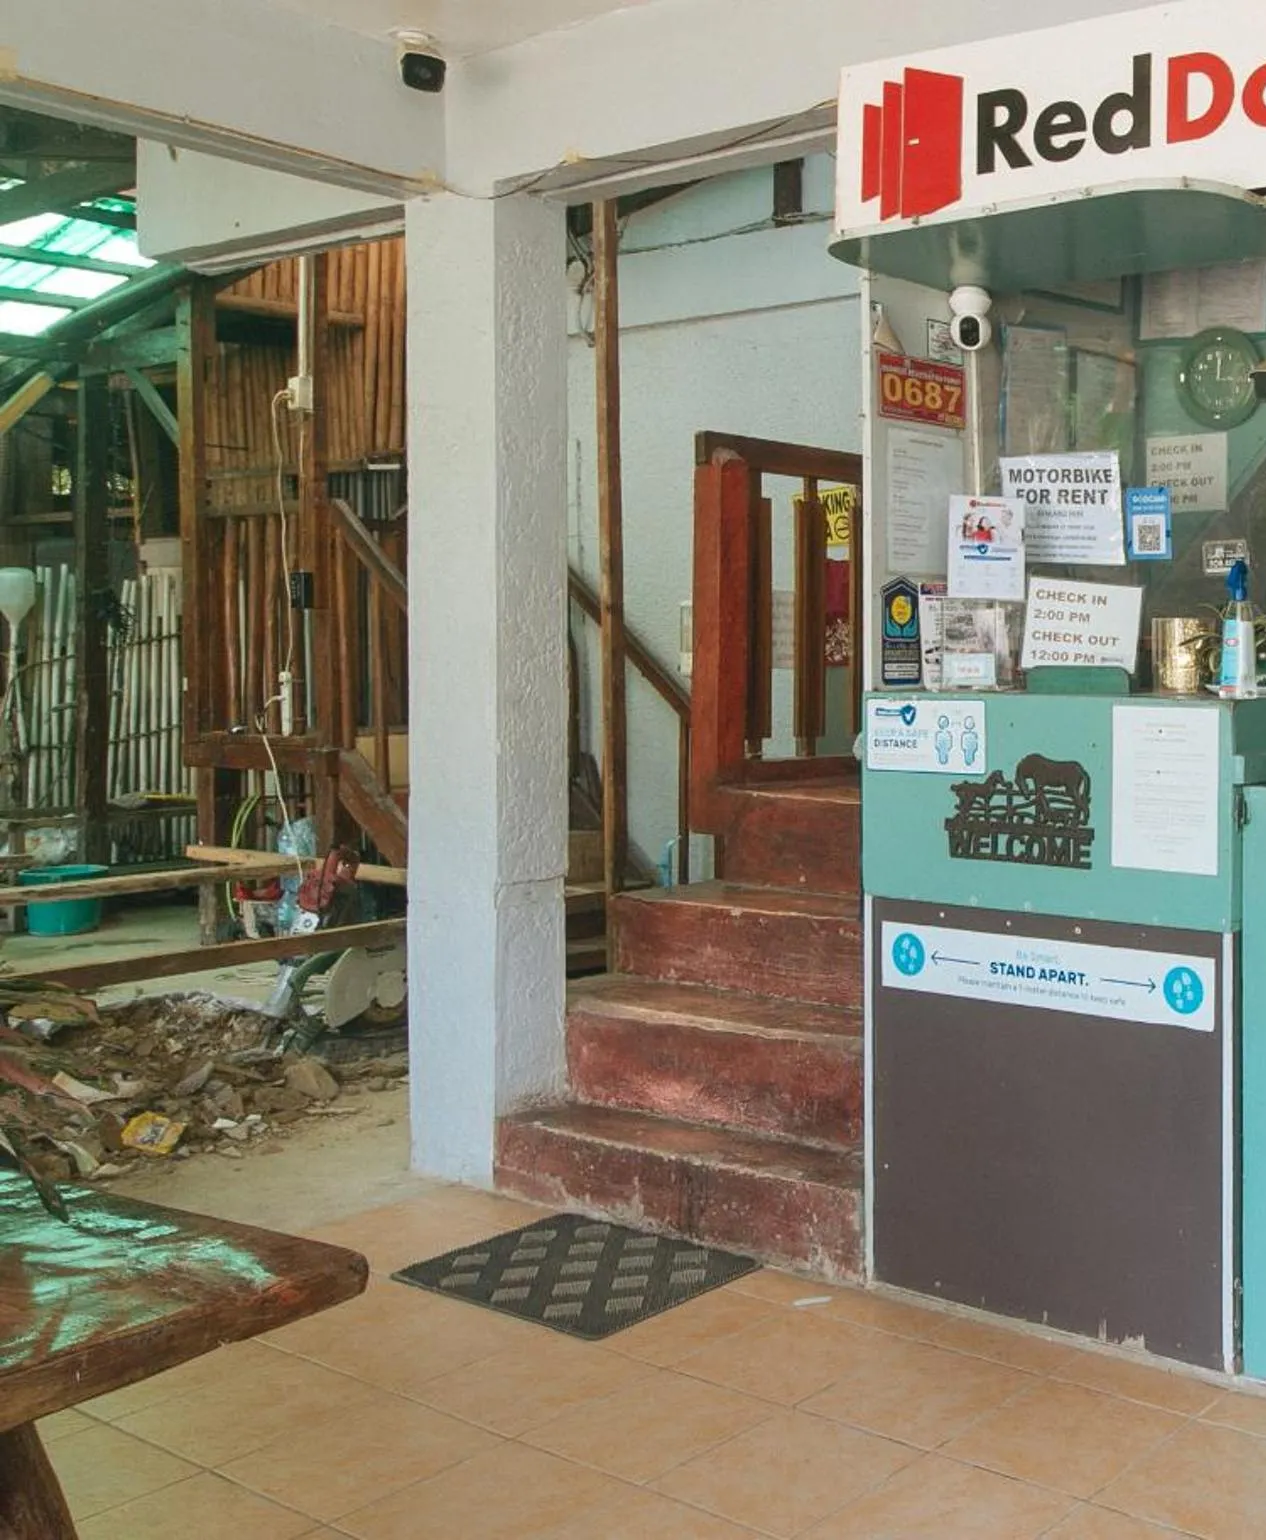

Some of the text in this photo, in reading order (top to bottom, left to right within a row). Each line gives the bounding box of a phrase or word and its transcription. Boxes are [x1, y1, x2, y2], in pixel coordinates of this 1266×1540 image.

[882, 371, 961, 413] 0687
[1008, 468, 1113, 484] MOTORBIKE
[1016, 488, 1051, 505] FOR
[1058, 488, 1109, 505] RENT
[1035, 588, 1108, 606] CHECK IN
[1033, 608, 1091, 623] 2:00 PM
[1031, 630, 1120, 647] CHECK OUT
[1030, 650, 1069, 662] 12:00
[1073, 652, 1095, 664] PM
[874, 739, 918, 749] DISTANCE
[950, 829, 1093, 870] WELCOME
[989, 961, 1089, 987] STAND APART.
